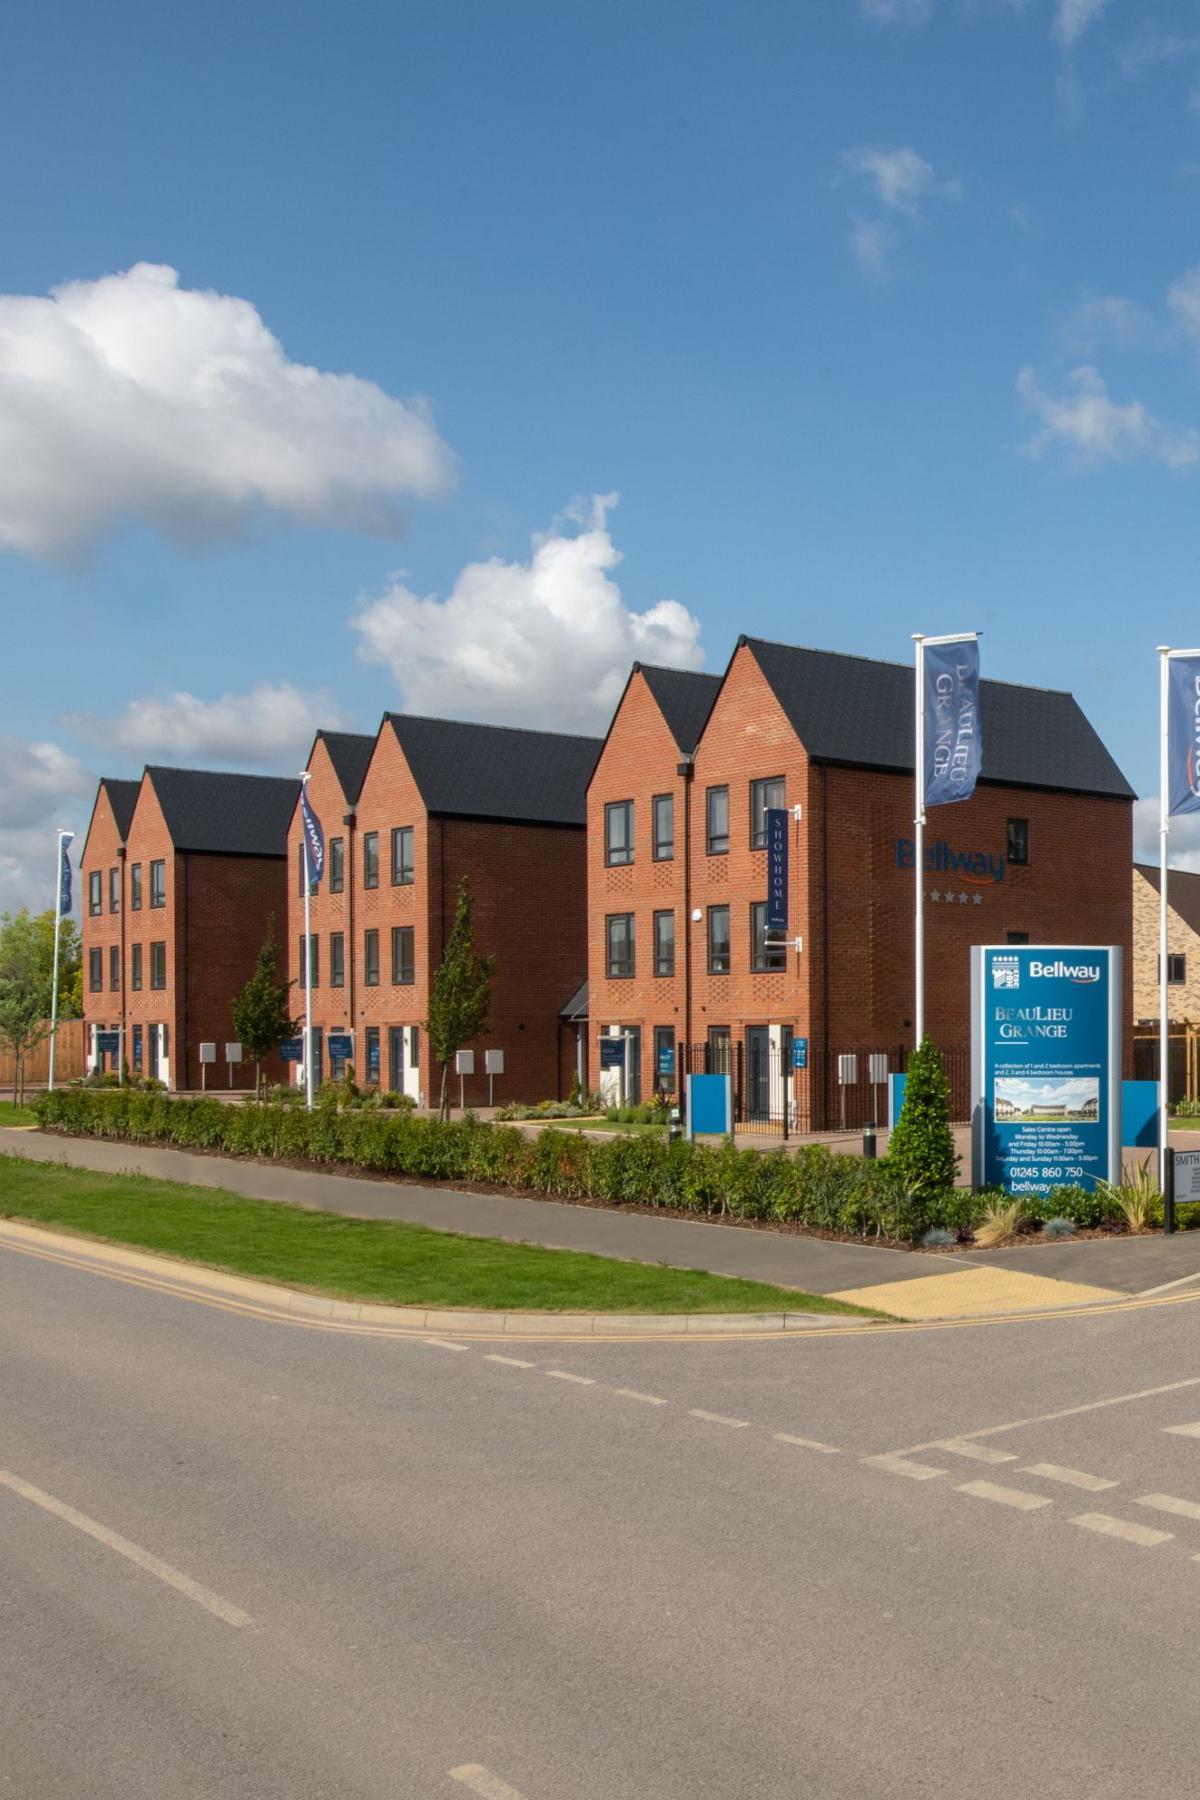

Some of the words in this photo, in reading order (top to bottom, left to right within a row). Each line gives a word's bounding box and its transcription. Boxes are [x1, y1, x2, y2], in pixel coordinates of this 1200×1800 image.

[935, 673, 954, 778] GRANGE
[773, 818, 783, 911] SHOWHOME
[896, 838, 1006, 881] Bellway
[1029, 961, 1101, 983] Bellway
[995, 1006, 1073, 1021] BEAULIEU
[1000, 1023, 1068, 1038] GRANGE
[1020, 1141, 1037, 1149] Friday
[1176, 1154, 1200, 1166] SMITH
[1010, 1167, 1038, 1178] 01245
[1041, 1167, 1062, 1177] 860
[1065, 1166, 1083, 1177] 750
